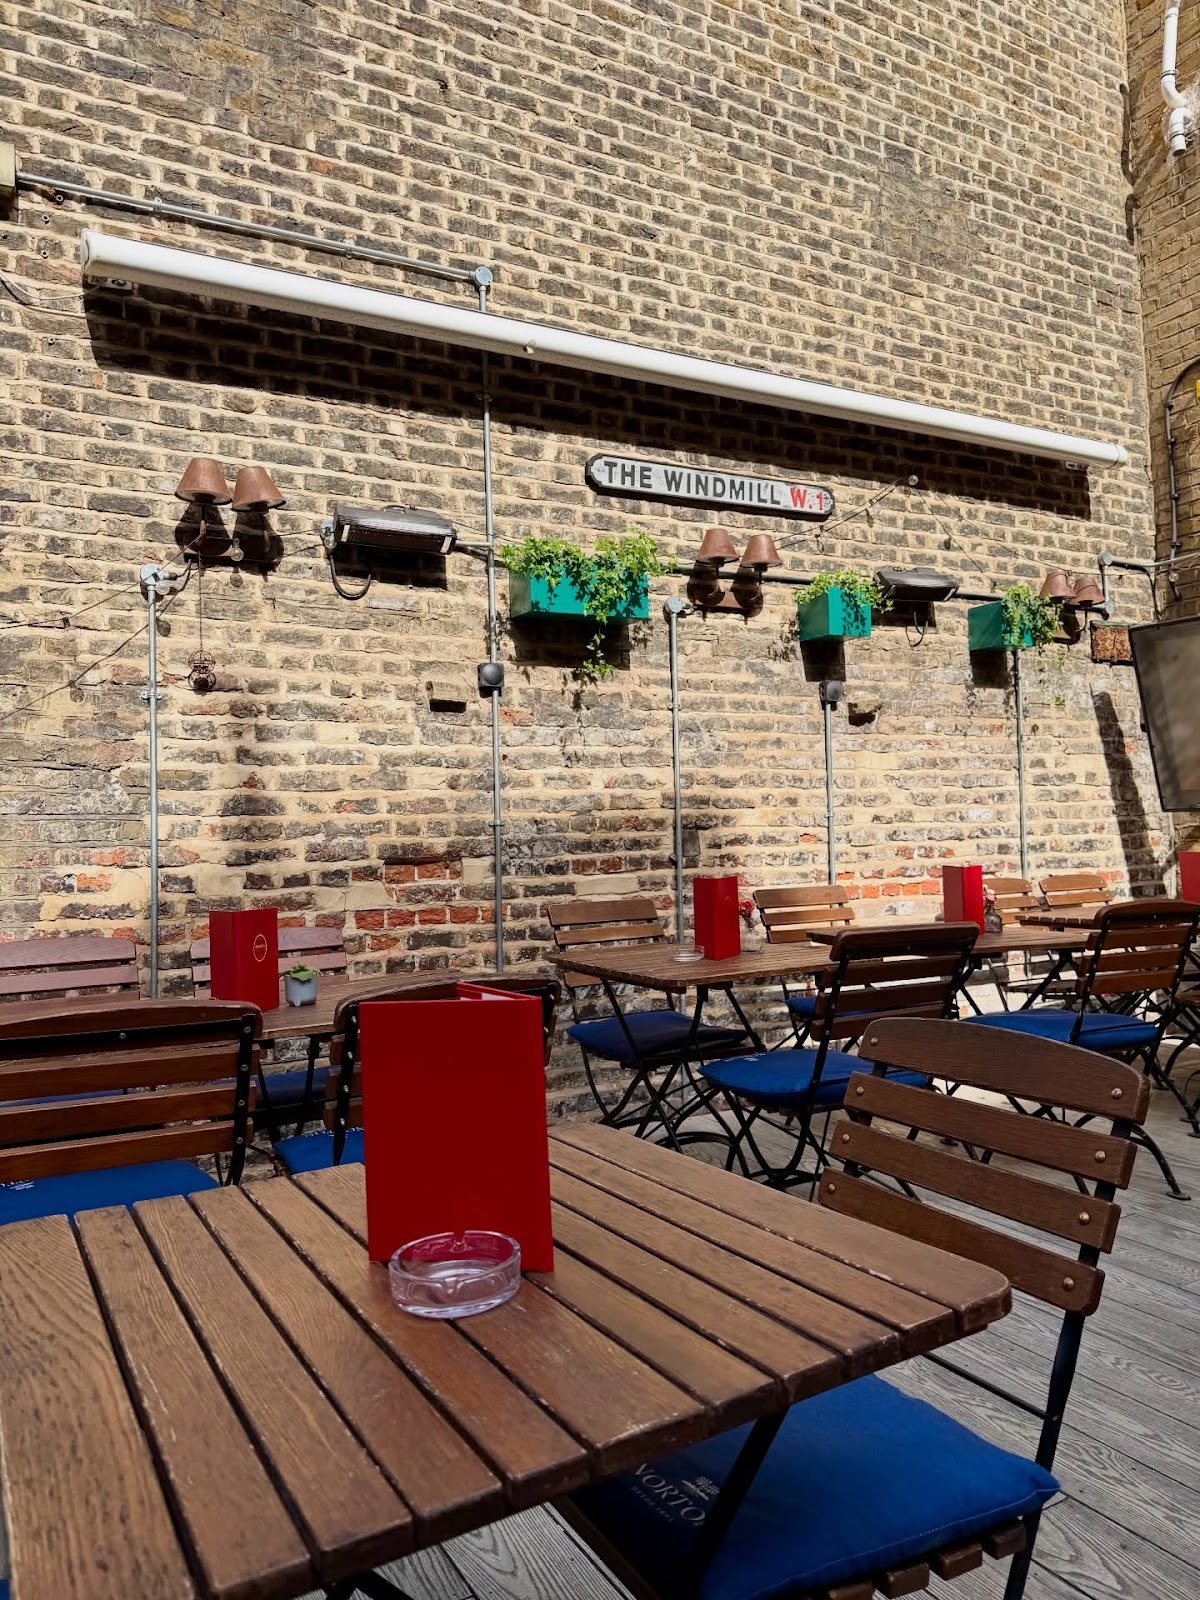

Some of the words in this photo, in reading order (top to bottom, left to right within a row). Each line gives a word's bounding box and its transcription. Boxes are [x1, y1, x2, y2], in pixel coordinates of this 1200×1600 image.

[604, 460, 652, 489] THE
[664, 469, 781, 505] WINDMILL
[790, 486, 824, 511] W.1
